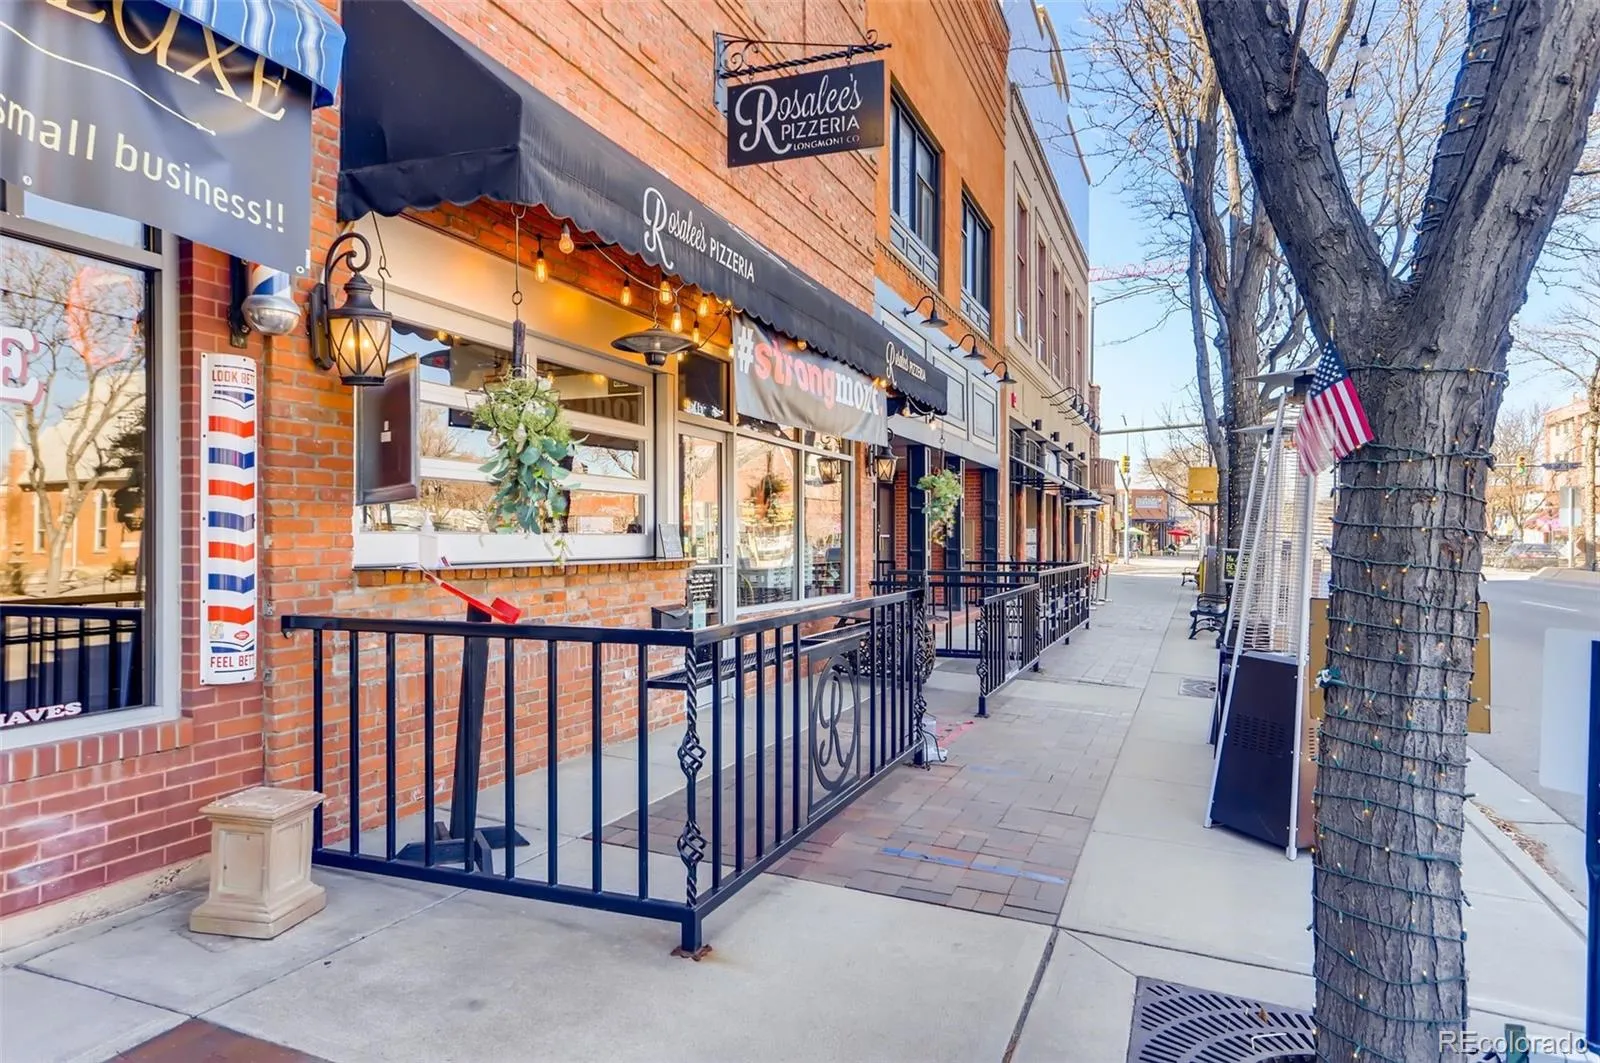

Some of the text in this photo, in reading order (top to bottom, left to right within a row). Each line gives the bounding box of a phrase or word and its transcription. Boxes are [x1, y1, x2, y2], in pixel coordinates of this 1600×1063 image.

[735, 73, 863, 155] Rosalee's
[781, 115, 860, 141] PIZZERIA
[793, 137, 844, 151] LONGMONT
[114, 132, 285, 233] business!!
[643, 187, 755, 283] Rosalee's PIZZERIA
[211, 369, 239, 384] LOOK
[210, 656, 234, 668] FEEL
